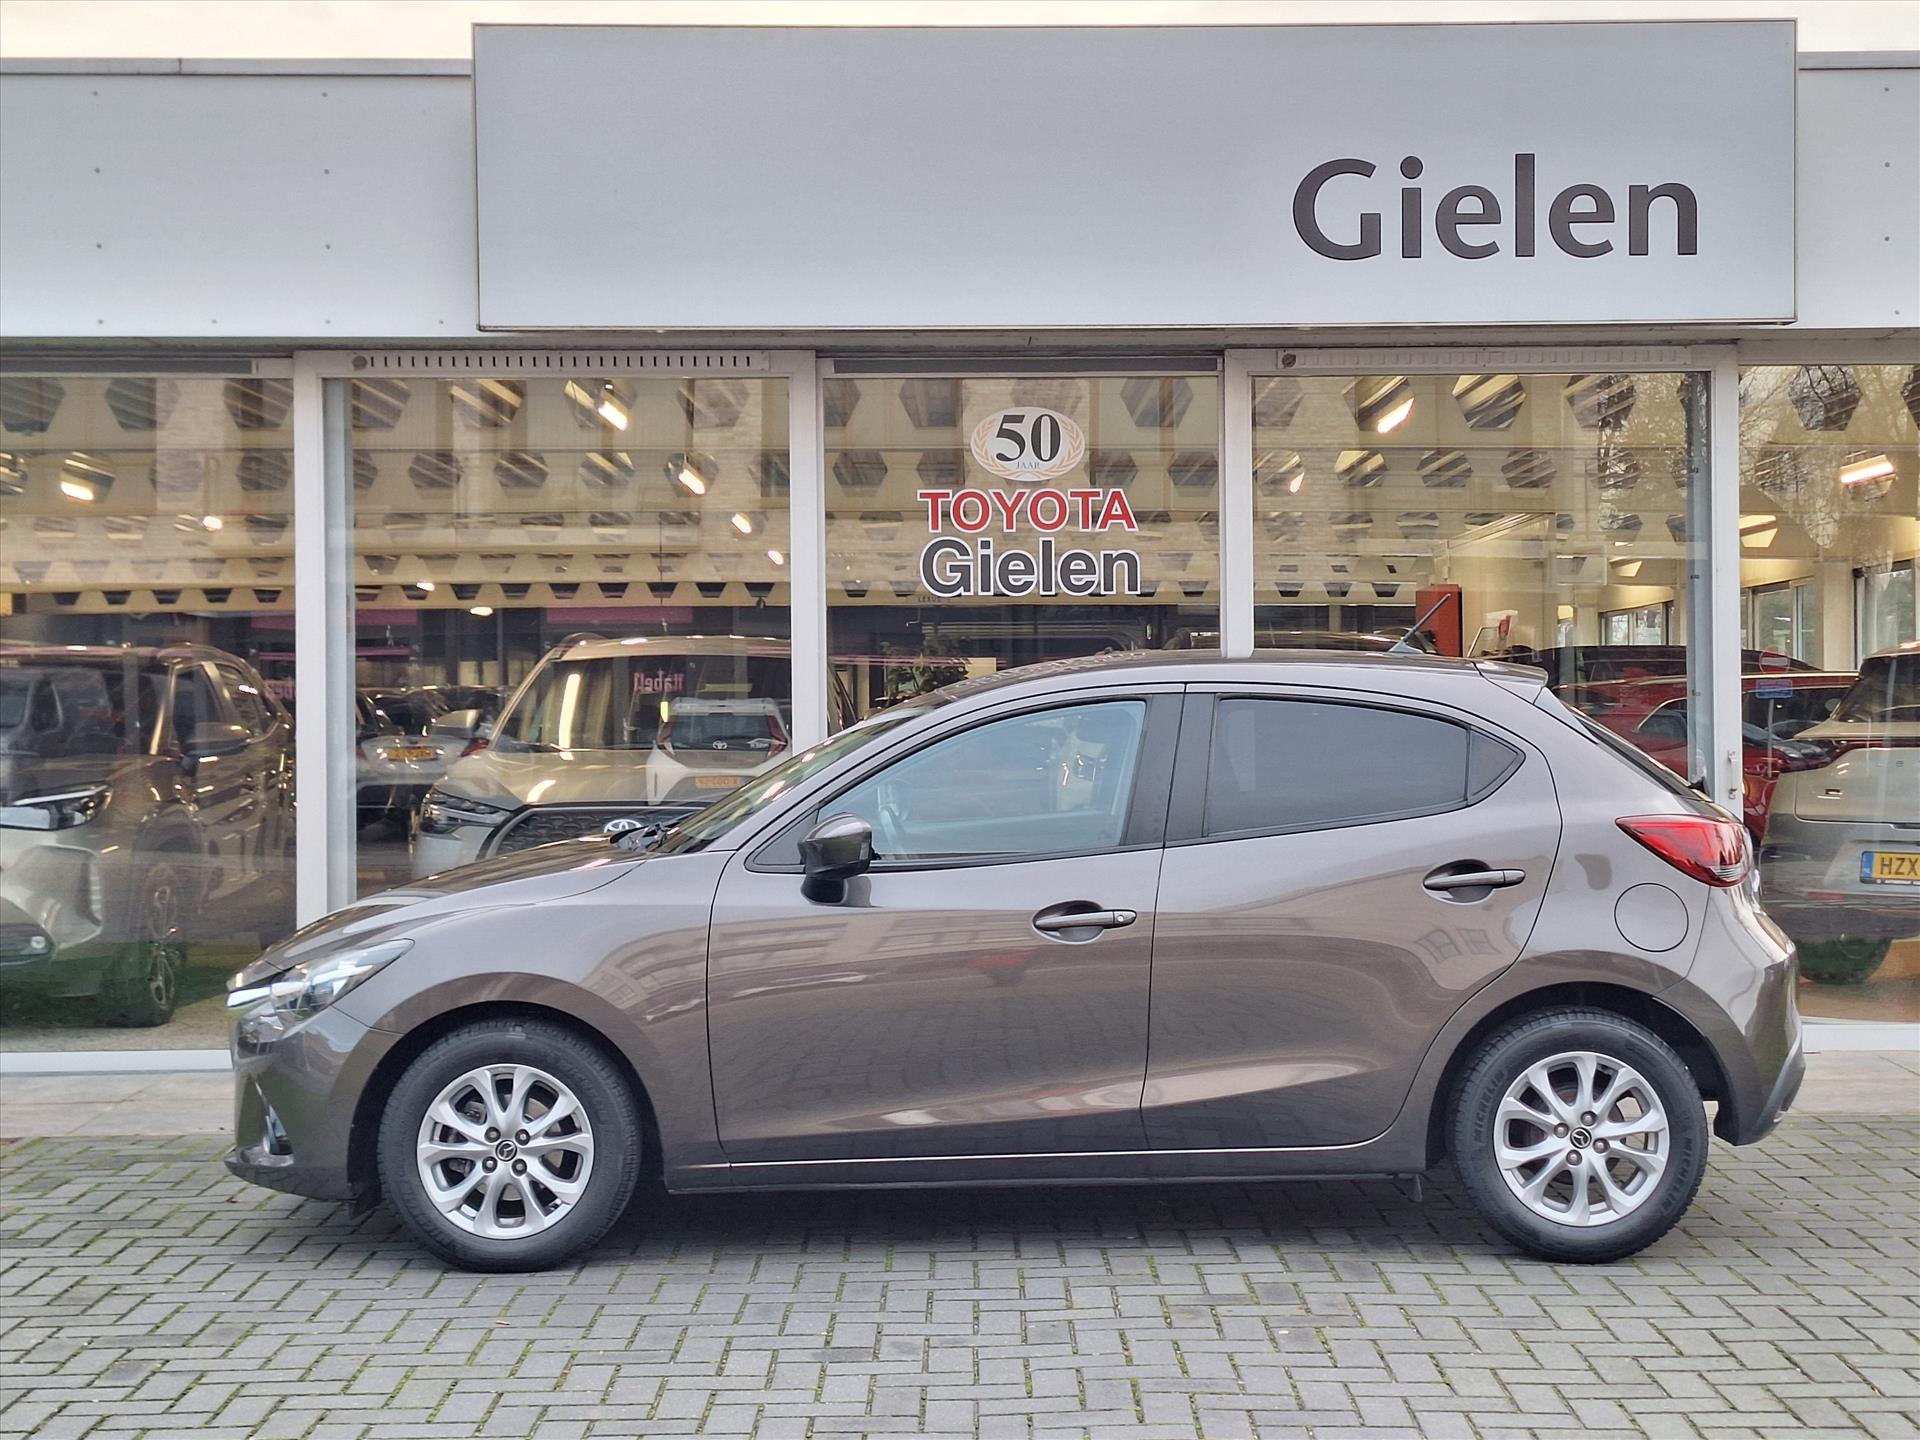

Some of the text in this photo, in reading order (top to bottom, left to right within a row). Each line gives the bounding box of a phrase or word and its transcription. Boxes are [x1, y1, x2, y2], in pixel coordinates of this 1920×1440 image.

[1292, 153, 1699, 260] Gielen
[995, 413, 1061, 462] 50
[917, 488, 1139, 533] TOYOTA
[920, 537, 1141, 597] Gielen
[1879, 856, 1919, 876] HZX
